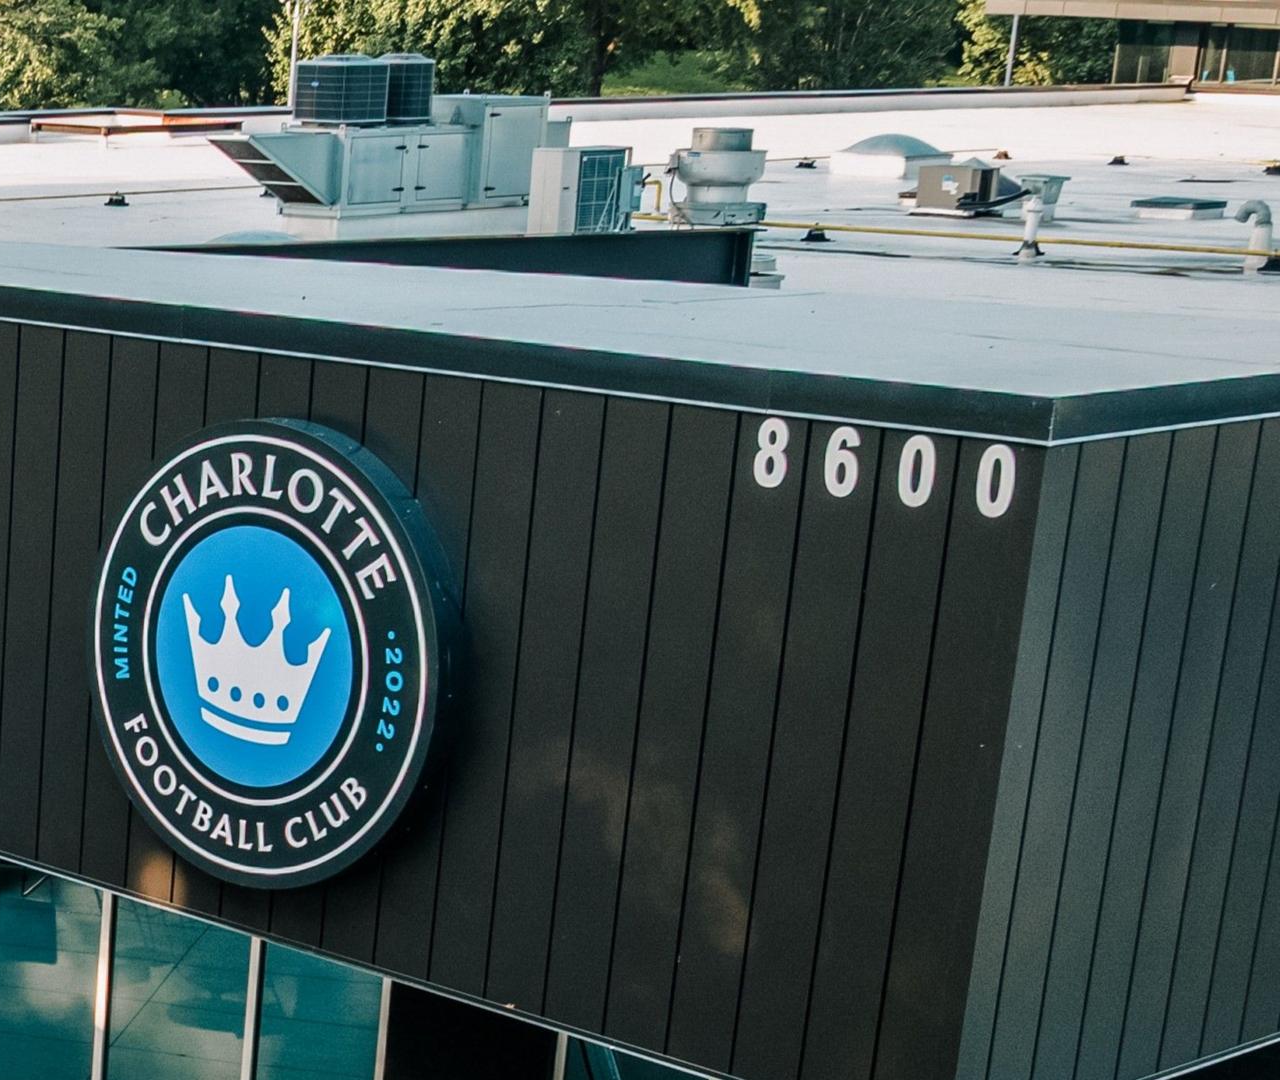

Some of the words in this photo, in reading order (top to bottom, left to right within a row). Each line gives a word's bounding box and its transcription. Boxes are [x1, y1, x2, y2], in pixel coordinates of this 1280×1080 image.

[139, 451, 397, 600] CHARLOTTE
[753, 417, 1016, 518] 8600
[114, 566, 138, 679] MINTED
[124, 713, 273, 853] FOOTBALL
[284, 775, 368, 849] CLUB
